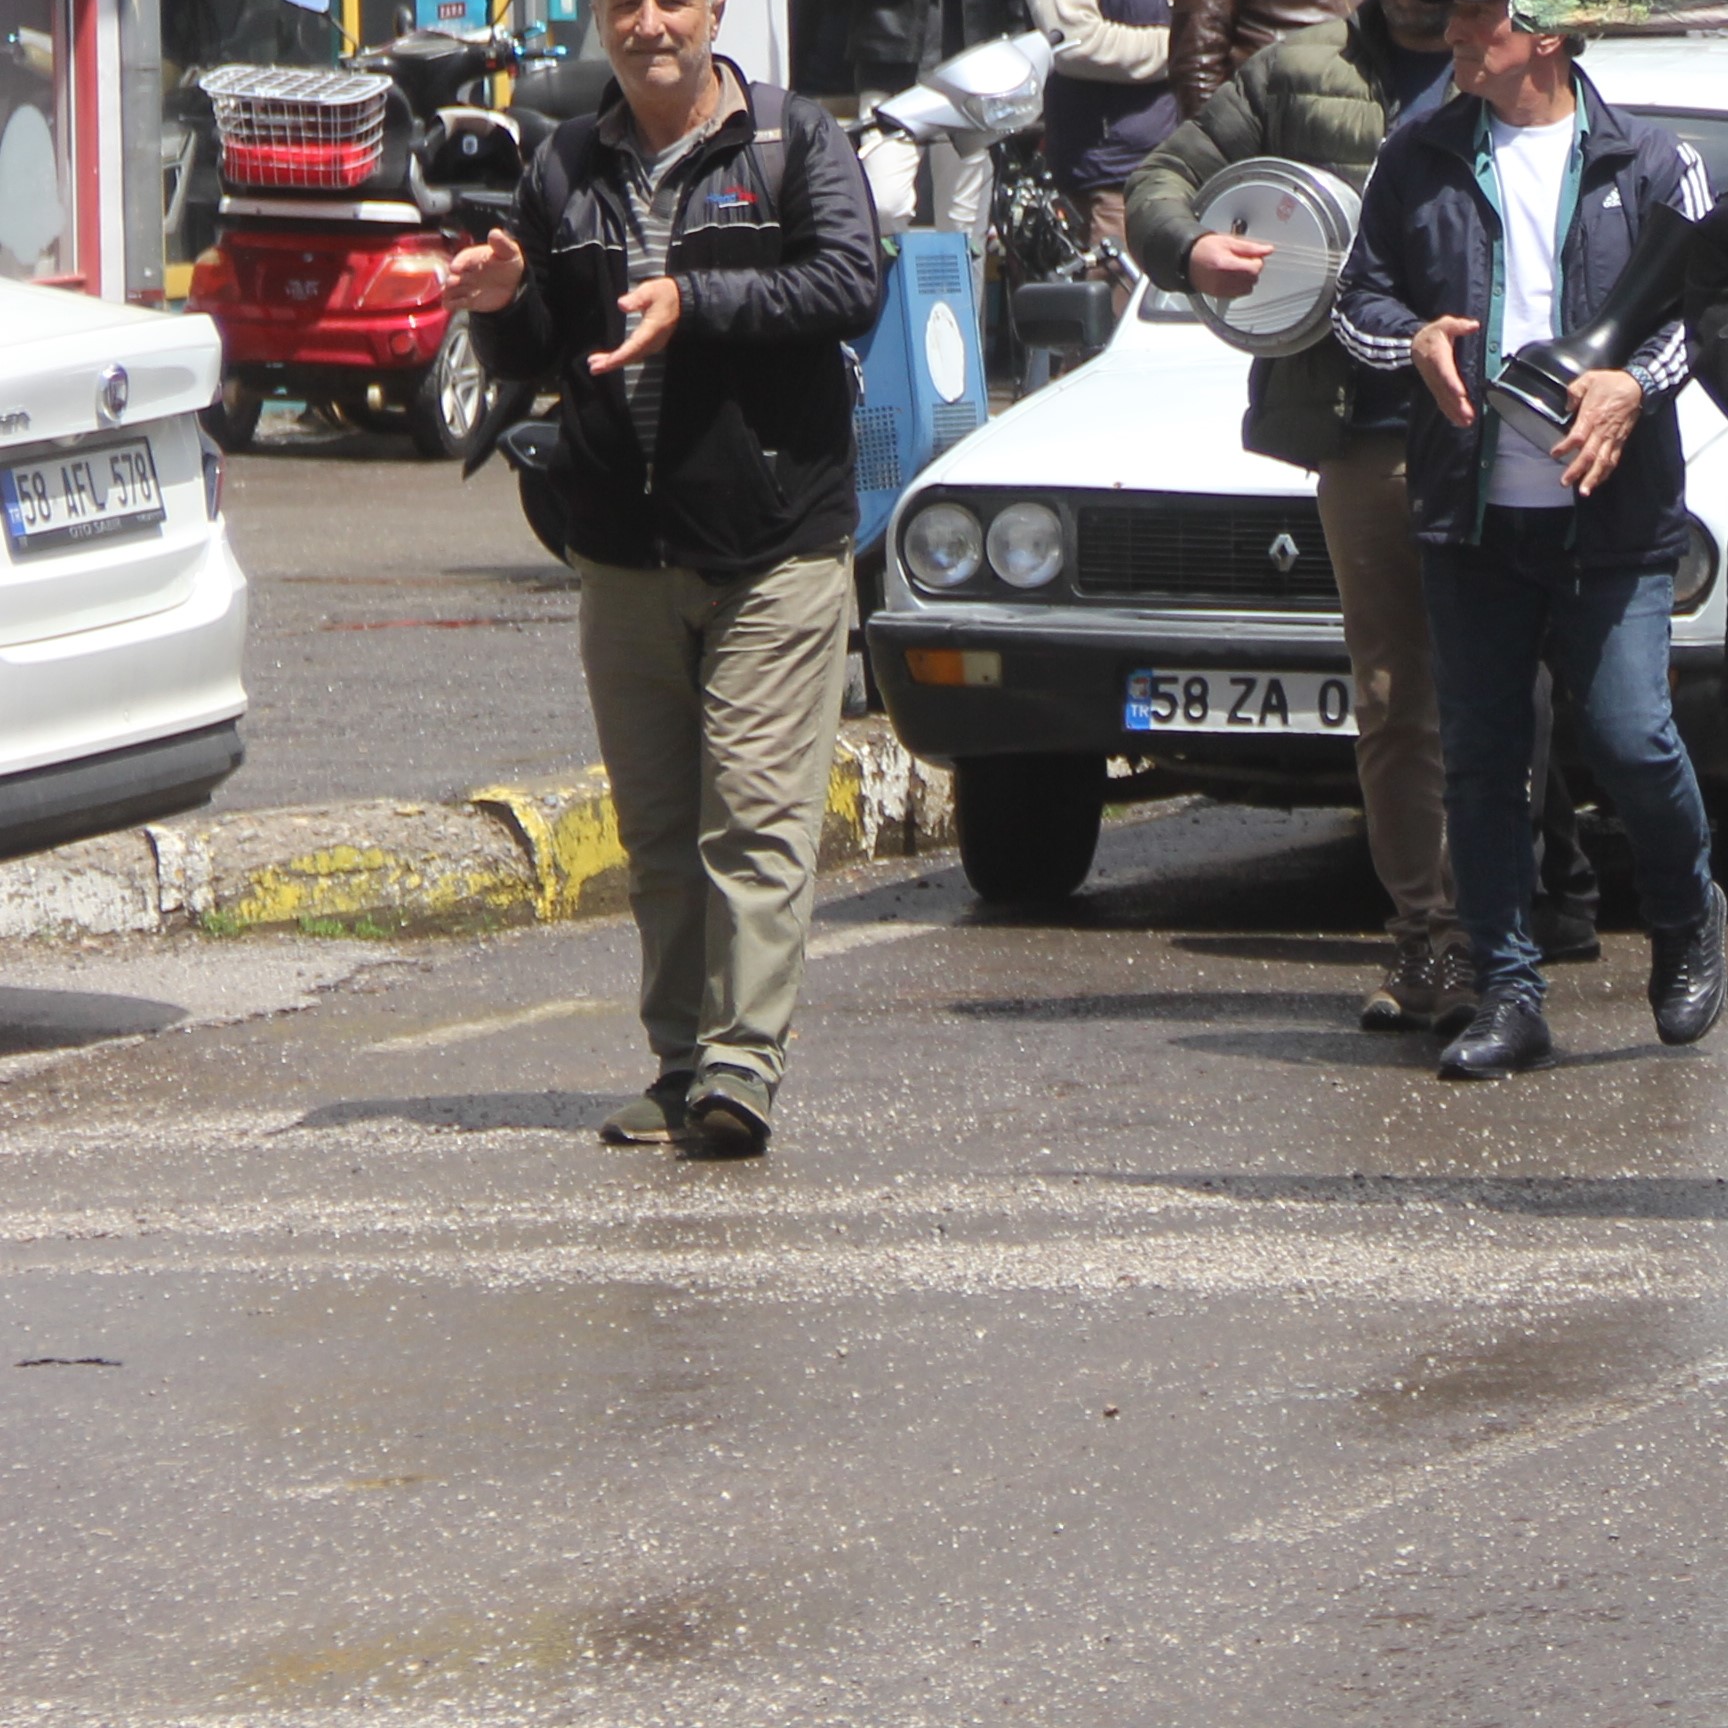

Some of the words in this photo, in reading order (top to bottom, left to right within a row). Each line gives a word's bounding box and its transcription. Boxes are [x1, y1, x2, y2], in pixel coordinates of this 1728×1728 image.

[16, 470, 51, 527] 58
[60, 460, 107, 519] AFL
[109, 452, 152, 508] 578
[1130, 704, 1150, 718] TR
[1150, 675, 1210, 724] 58
[1226, 676, 1290, 727] ZA
[1317, 678, 1350, 728] 0
